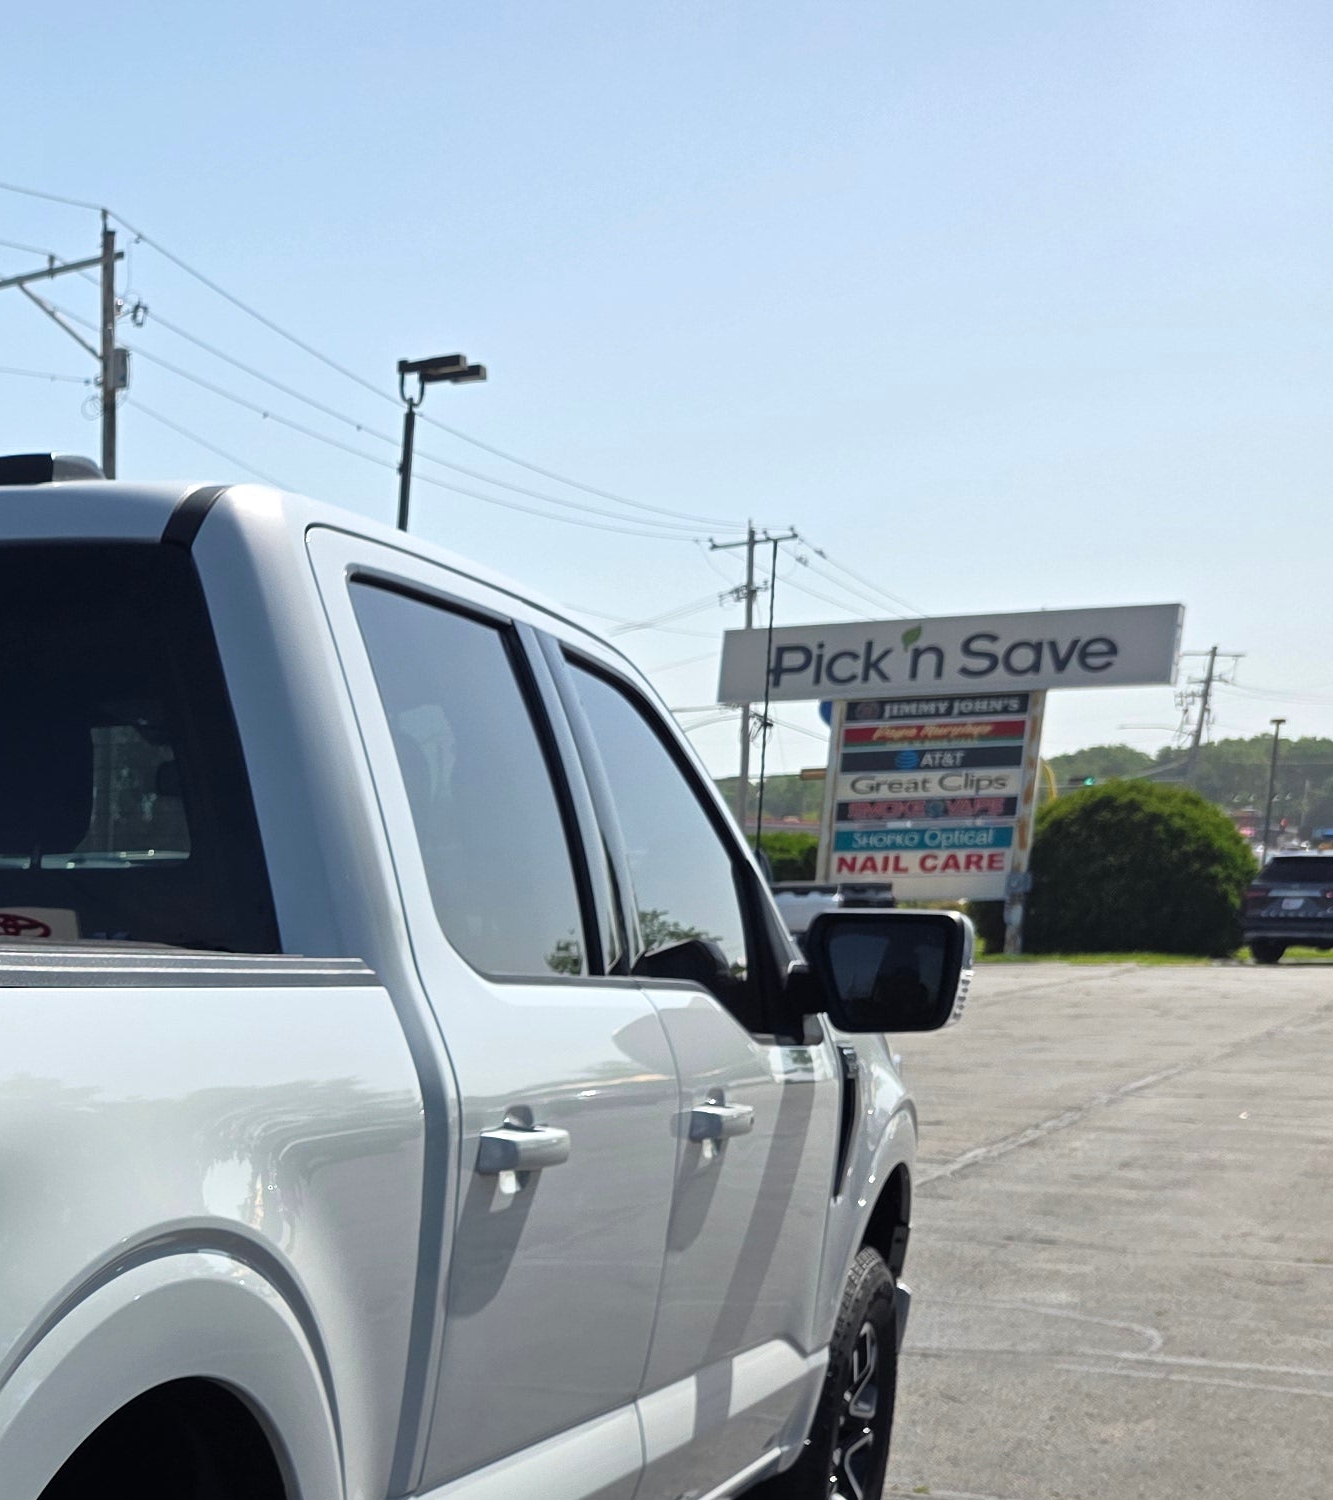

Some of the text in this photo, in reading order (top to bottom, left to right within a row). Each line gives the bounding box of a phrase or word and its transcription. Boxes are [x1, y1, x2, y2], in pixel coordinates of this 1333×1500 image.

[958, 632, 1119, 679] Save
[883, 696, 1020, 719] JIMMY JOHN'S
[919, 751, 967, 769] AT&T
[850, 771, 1011, 796] Great Clips
[923, 828, 996, 849] Optical
[836, 851, 1006, 875] NAIL CARE
